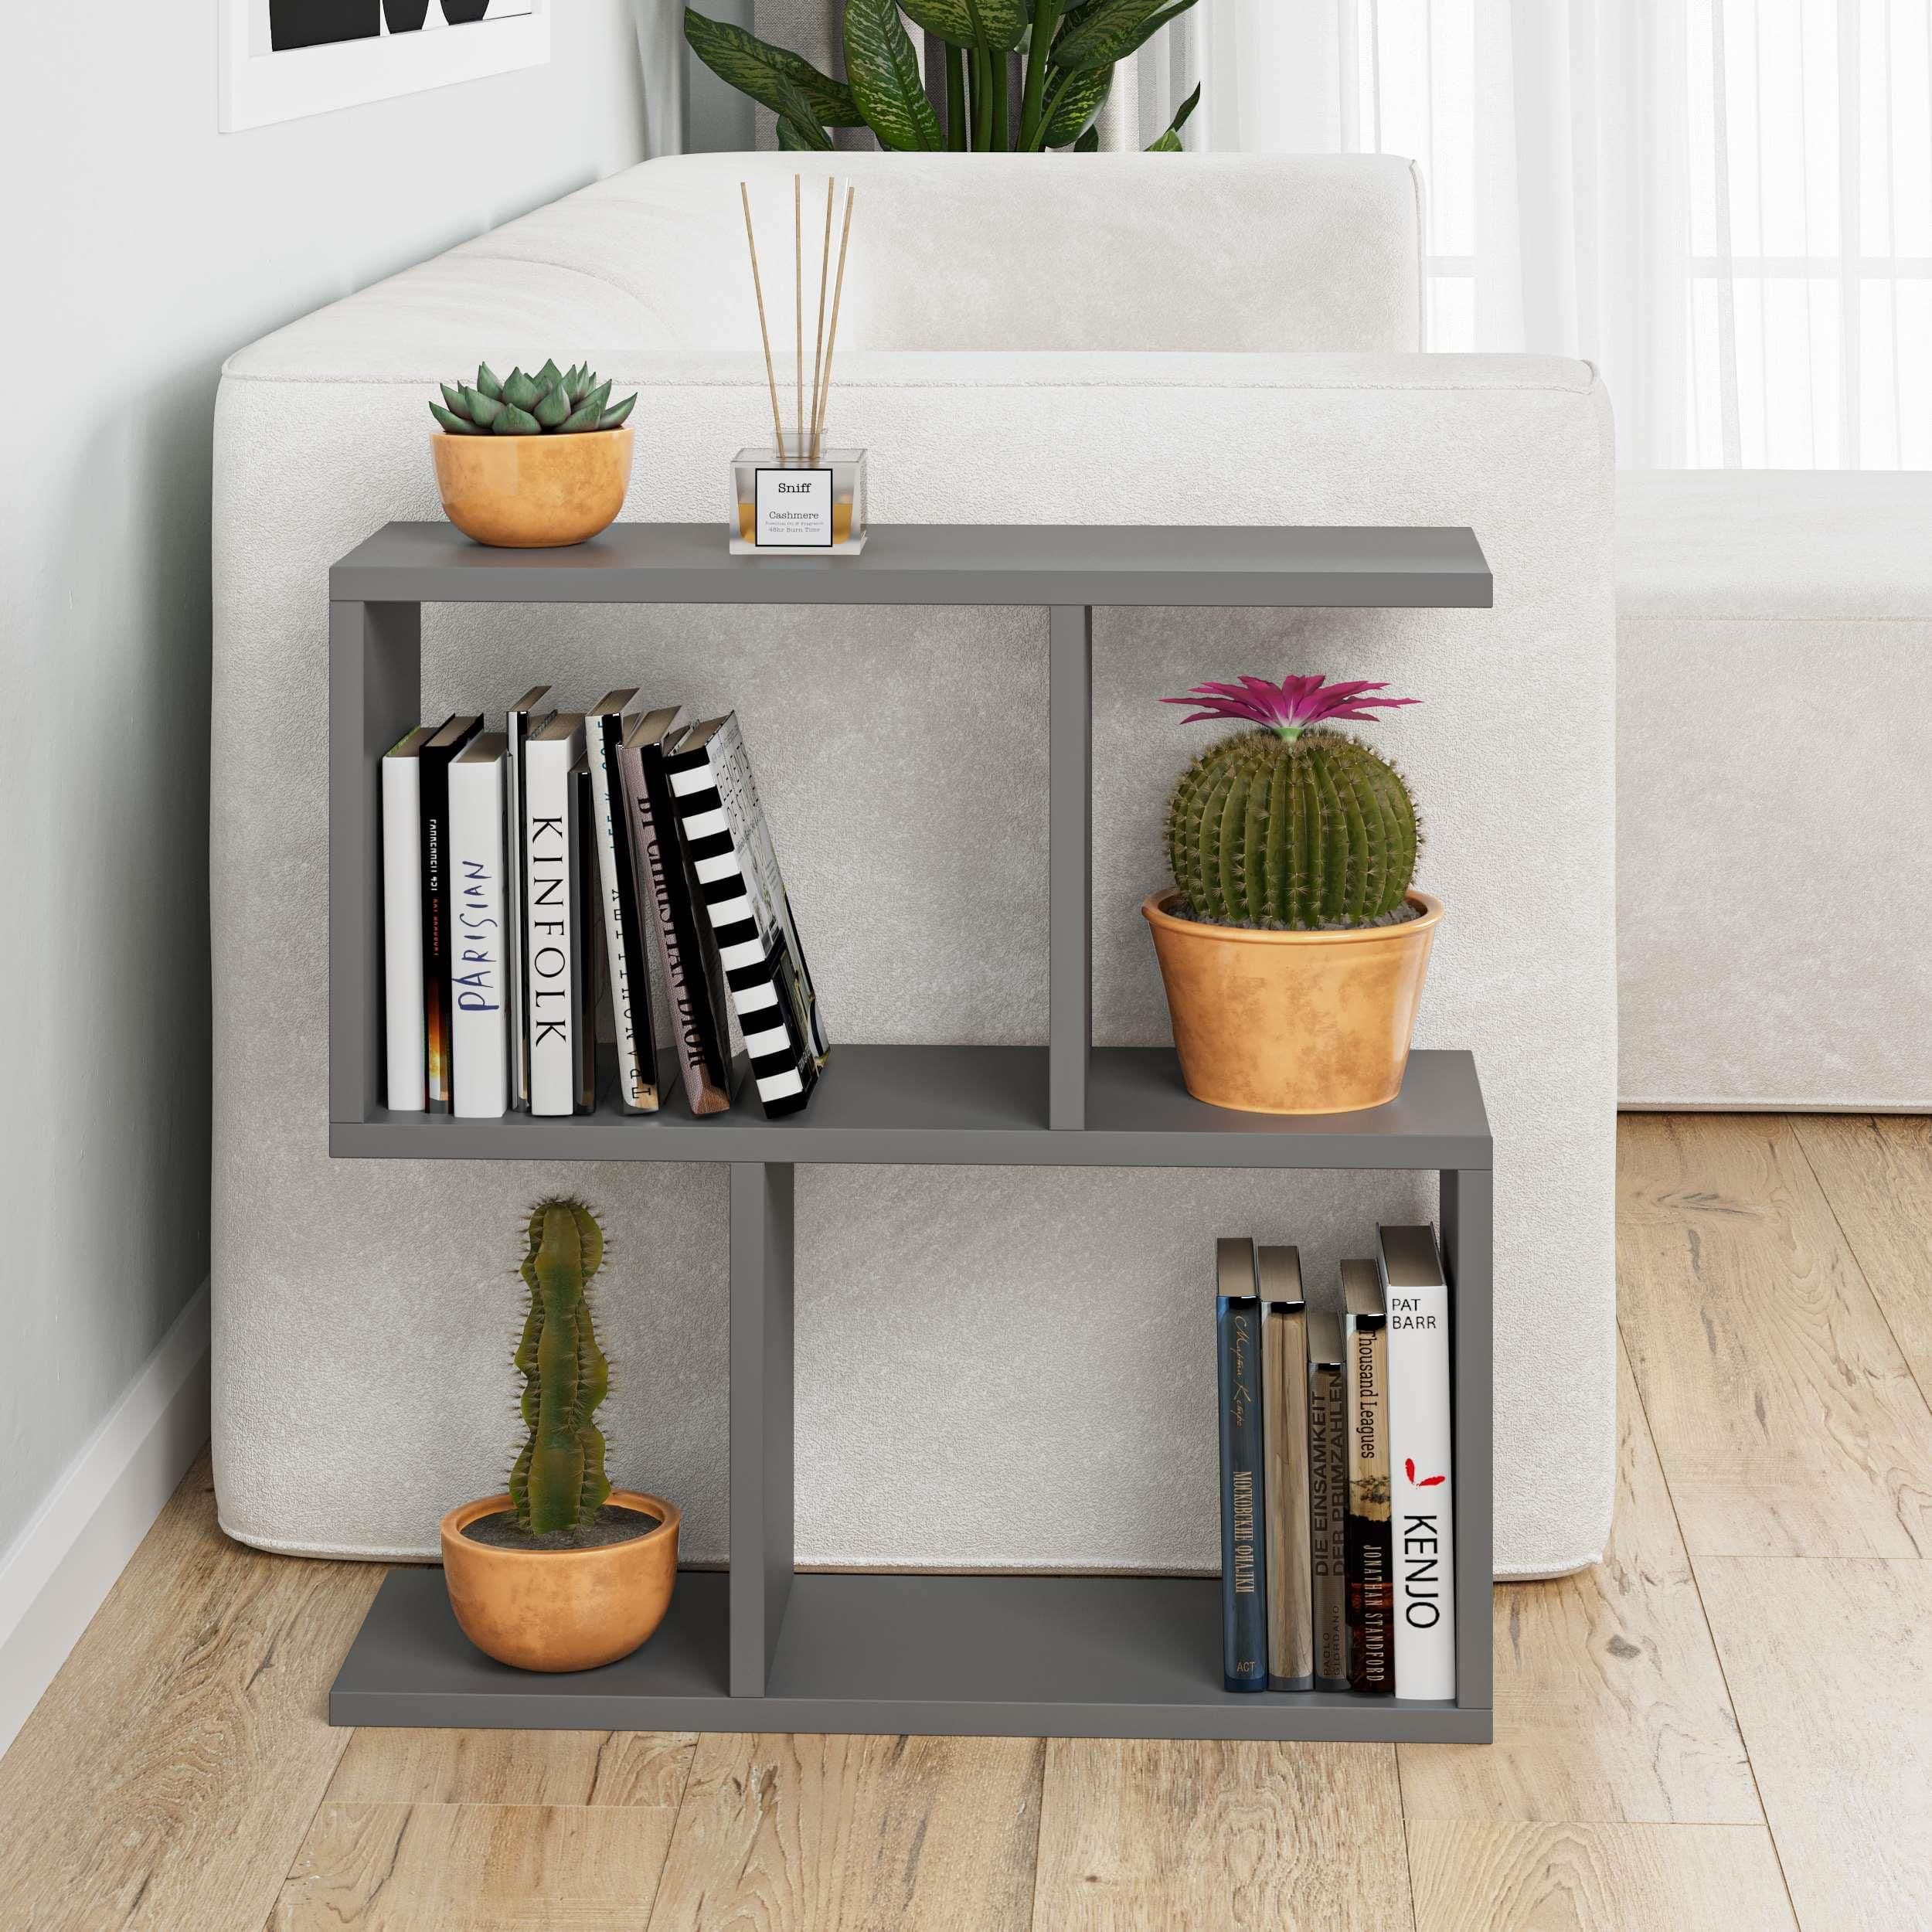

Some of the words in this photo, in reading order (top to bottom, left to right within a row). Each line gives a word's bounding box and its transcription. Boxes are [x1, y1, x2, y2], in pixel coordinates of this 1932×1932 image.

[769, 511, 819, 519] Cashmere
[778, 482, 811, 493] Sniff
[451, 860, 500, 1011] PARISIAN
[532, 816, 566, 1047] KINFOLK
[677, 997, 705, 1070] DIOR
[1392, 1298, 1421, 1311] PAT
[1393, 1316, 1437, 1329] BARR
[1359, 1329, 1379, 1397] Thousand
[1311, 1391, 1328, 1532] EINSAMKEIT
[1329, 1372, 1344, 1522] PRIMZAHLEN
[1355, 1400, 1378, 1458] Leagues
[1233, 1471, 1253, 1541] МОСКОВСКИЕ
[1235, 1545, 1254, 1594] ФИАЛКИ
[1315, 1539, 1328, 1577] DIE
[1332, 1531, 1345, 1577] DER
[1363, 1545, 1383, 1607] JONATHAN
[1403, 1515, 1440, 1629] KENJO
[1365, 1613, 1384, 1682] STANDFORD
